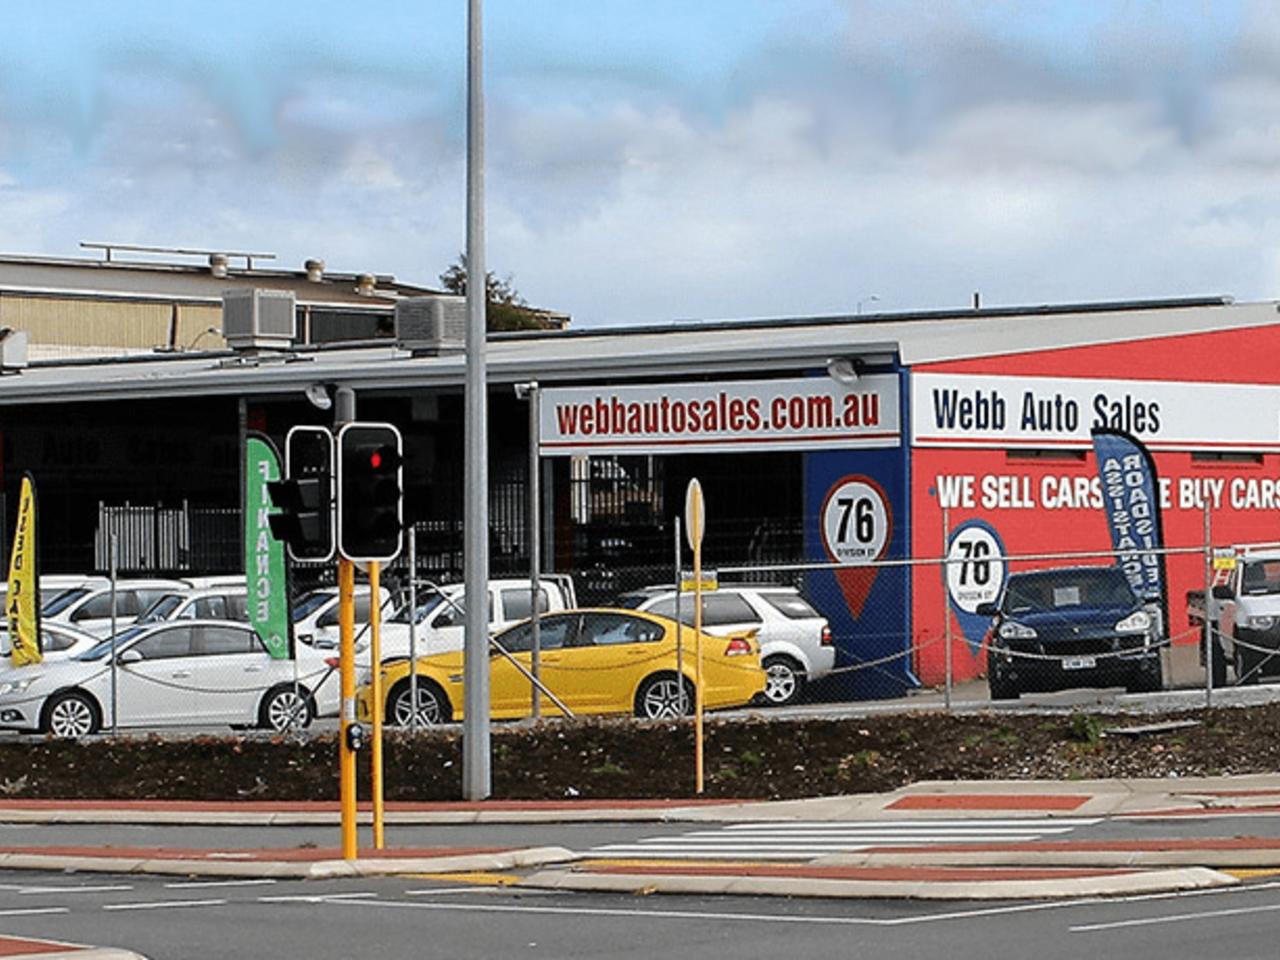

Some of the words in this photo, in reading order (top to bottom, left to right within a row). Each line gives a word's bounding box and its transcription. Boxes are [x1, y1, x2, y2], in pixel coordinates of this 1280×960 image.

[556, 392, 880, 435] webbautosales.com.au
[933, 388, 1006, 431] Webb
[1020, 391, 1078, 432] Auto
[1092, 393, 1160, 434] Sales
[936, 476, 976, 508] WE
[982, 476, 1037, 509] SELL
[1041, 475, 1104, 509] CARS
[1179, 478, 1226, 509] BUY
[836, 497, 875, 544] 76
[958, 540, 991, 586] 76
